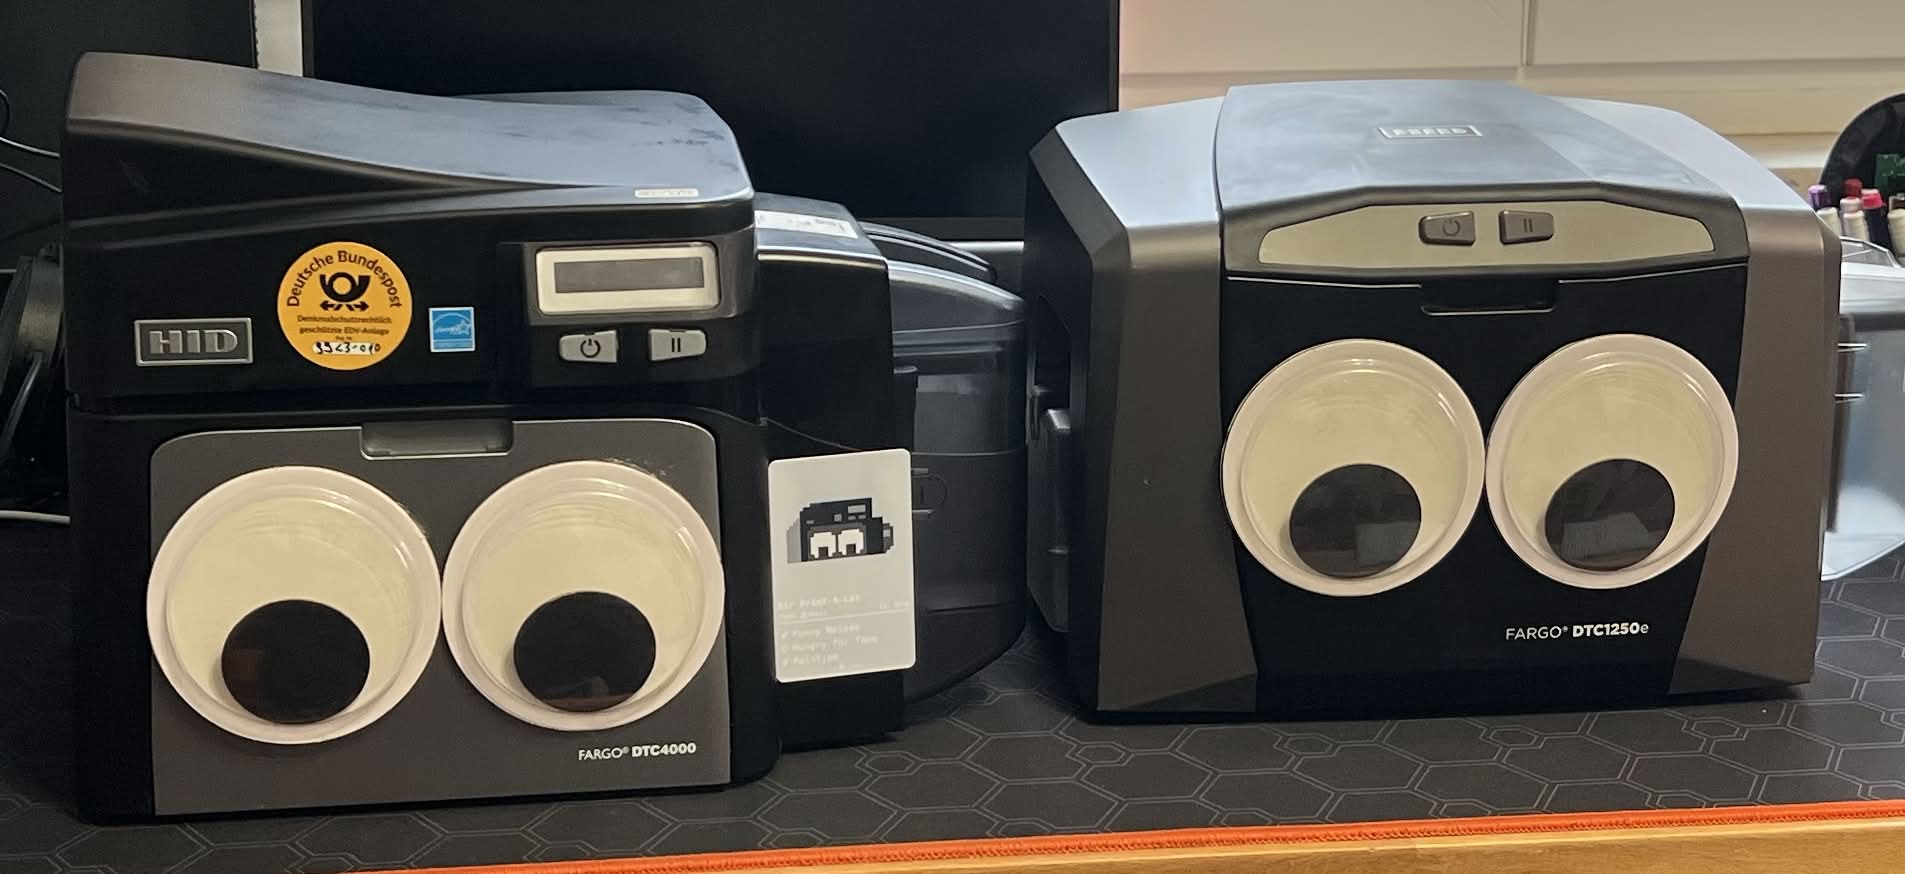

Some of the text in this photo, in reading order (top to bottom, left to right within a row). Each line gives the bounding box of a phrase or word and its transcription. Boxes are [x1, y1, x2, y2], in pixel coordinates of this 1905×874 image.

[286, 250, 402, 308] Deutsche Bundespost
[149, 329, 238, 354] HID
[1572, 621, 1649, 638] DTC1250e
[631, 742, 697, 758] DTC4000
